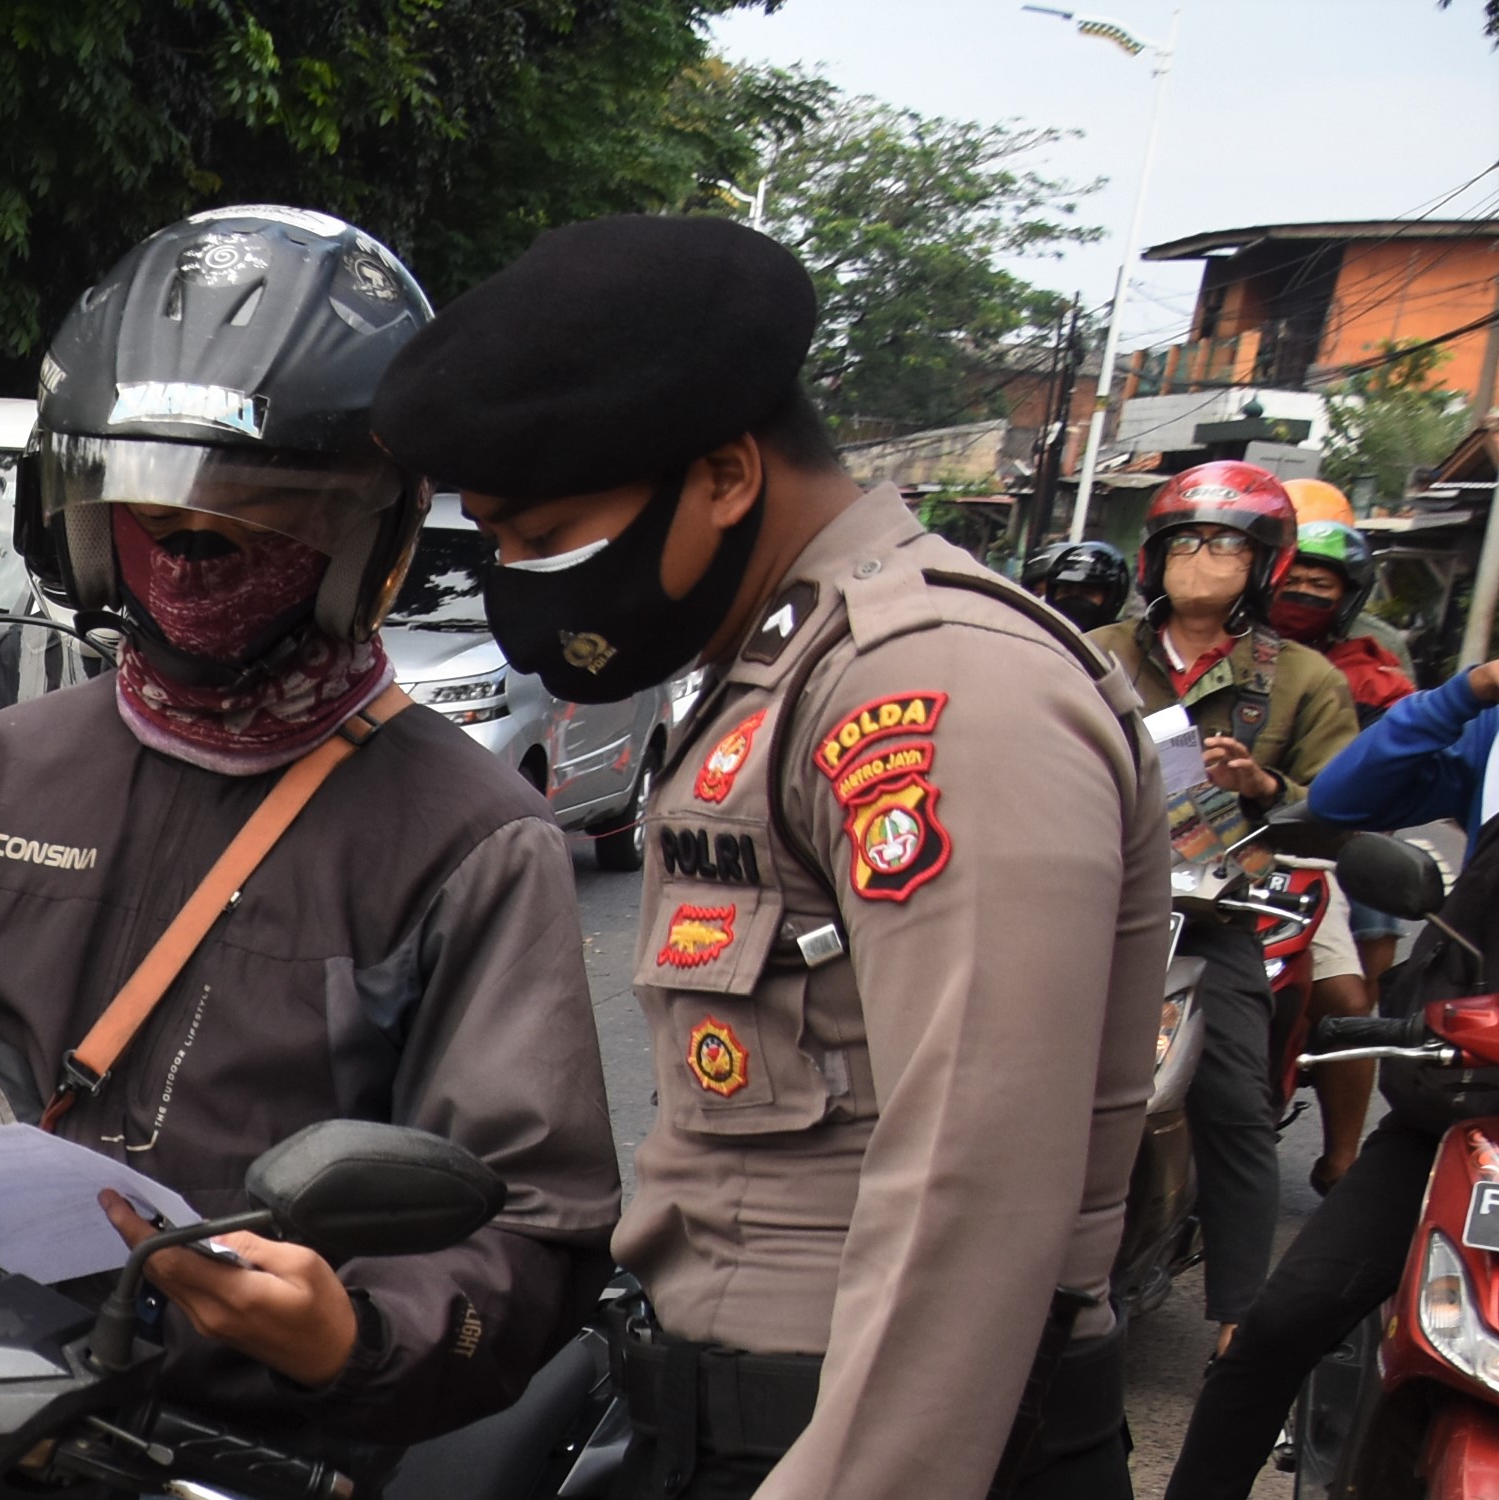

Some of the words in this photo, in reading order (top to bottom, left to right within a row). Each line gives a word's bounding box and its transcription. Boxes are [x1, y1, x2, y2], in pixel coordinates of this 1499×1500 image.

[823, 698, 927, 768] POLDA
[659, 826, 759, 883] POLRI
[155, 1106, 167, 1127] THE
[162, 1050, 186, 1102] OUTDOOR
[184, 984, 211, 1047] LIFESTYLE
[453, 1304, 482, 1358] LIGHT
